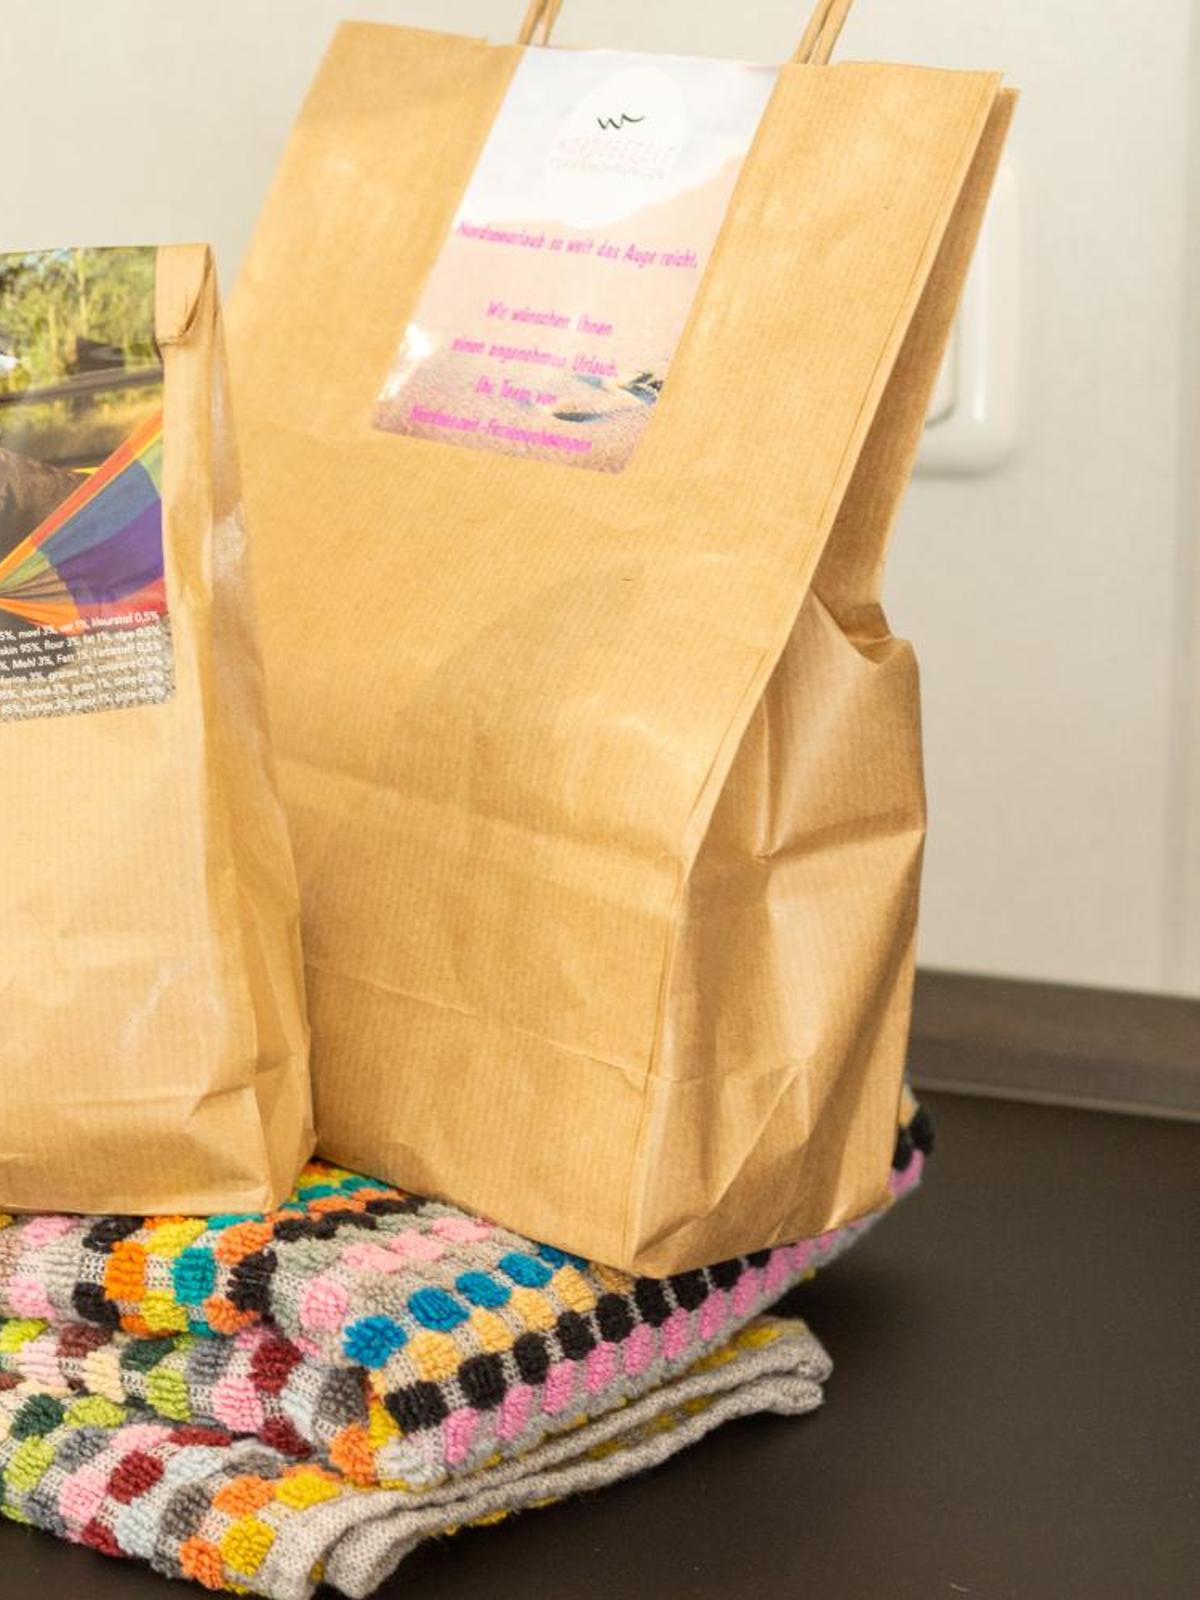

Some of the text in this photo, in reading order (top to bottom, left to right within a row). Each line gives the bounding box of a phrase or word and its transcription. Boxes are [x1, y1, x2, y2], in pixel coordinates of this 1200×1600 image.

[597, 239, 621, 259] das
[622, 243, 657, 270] Auge
[135, 611, 159, 623] 0,5%
[0, 645, 18, 657] skin
[44, 639, 65, 650] flour
